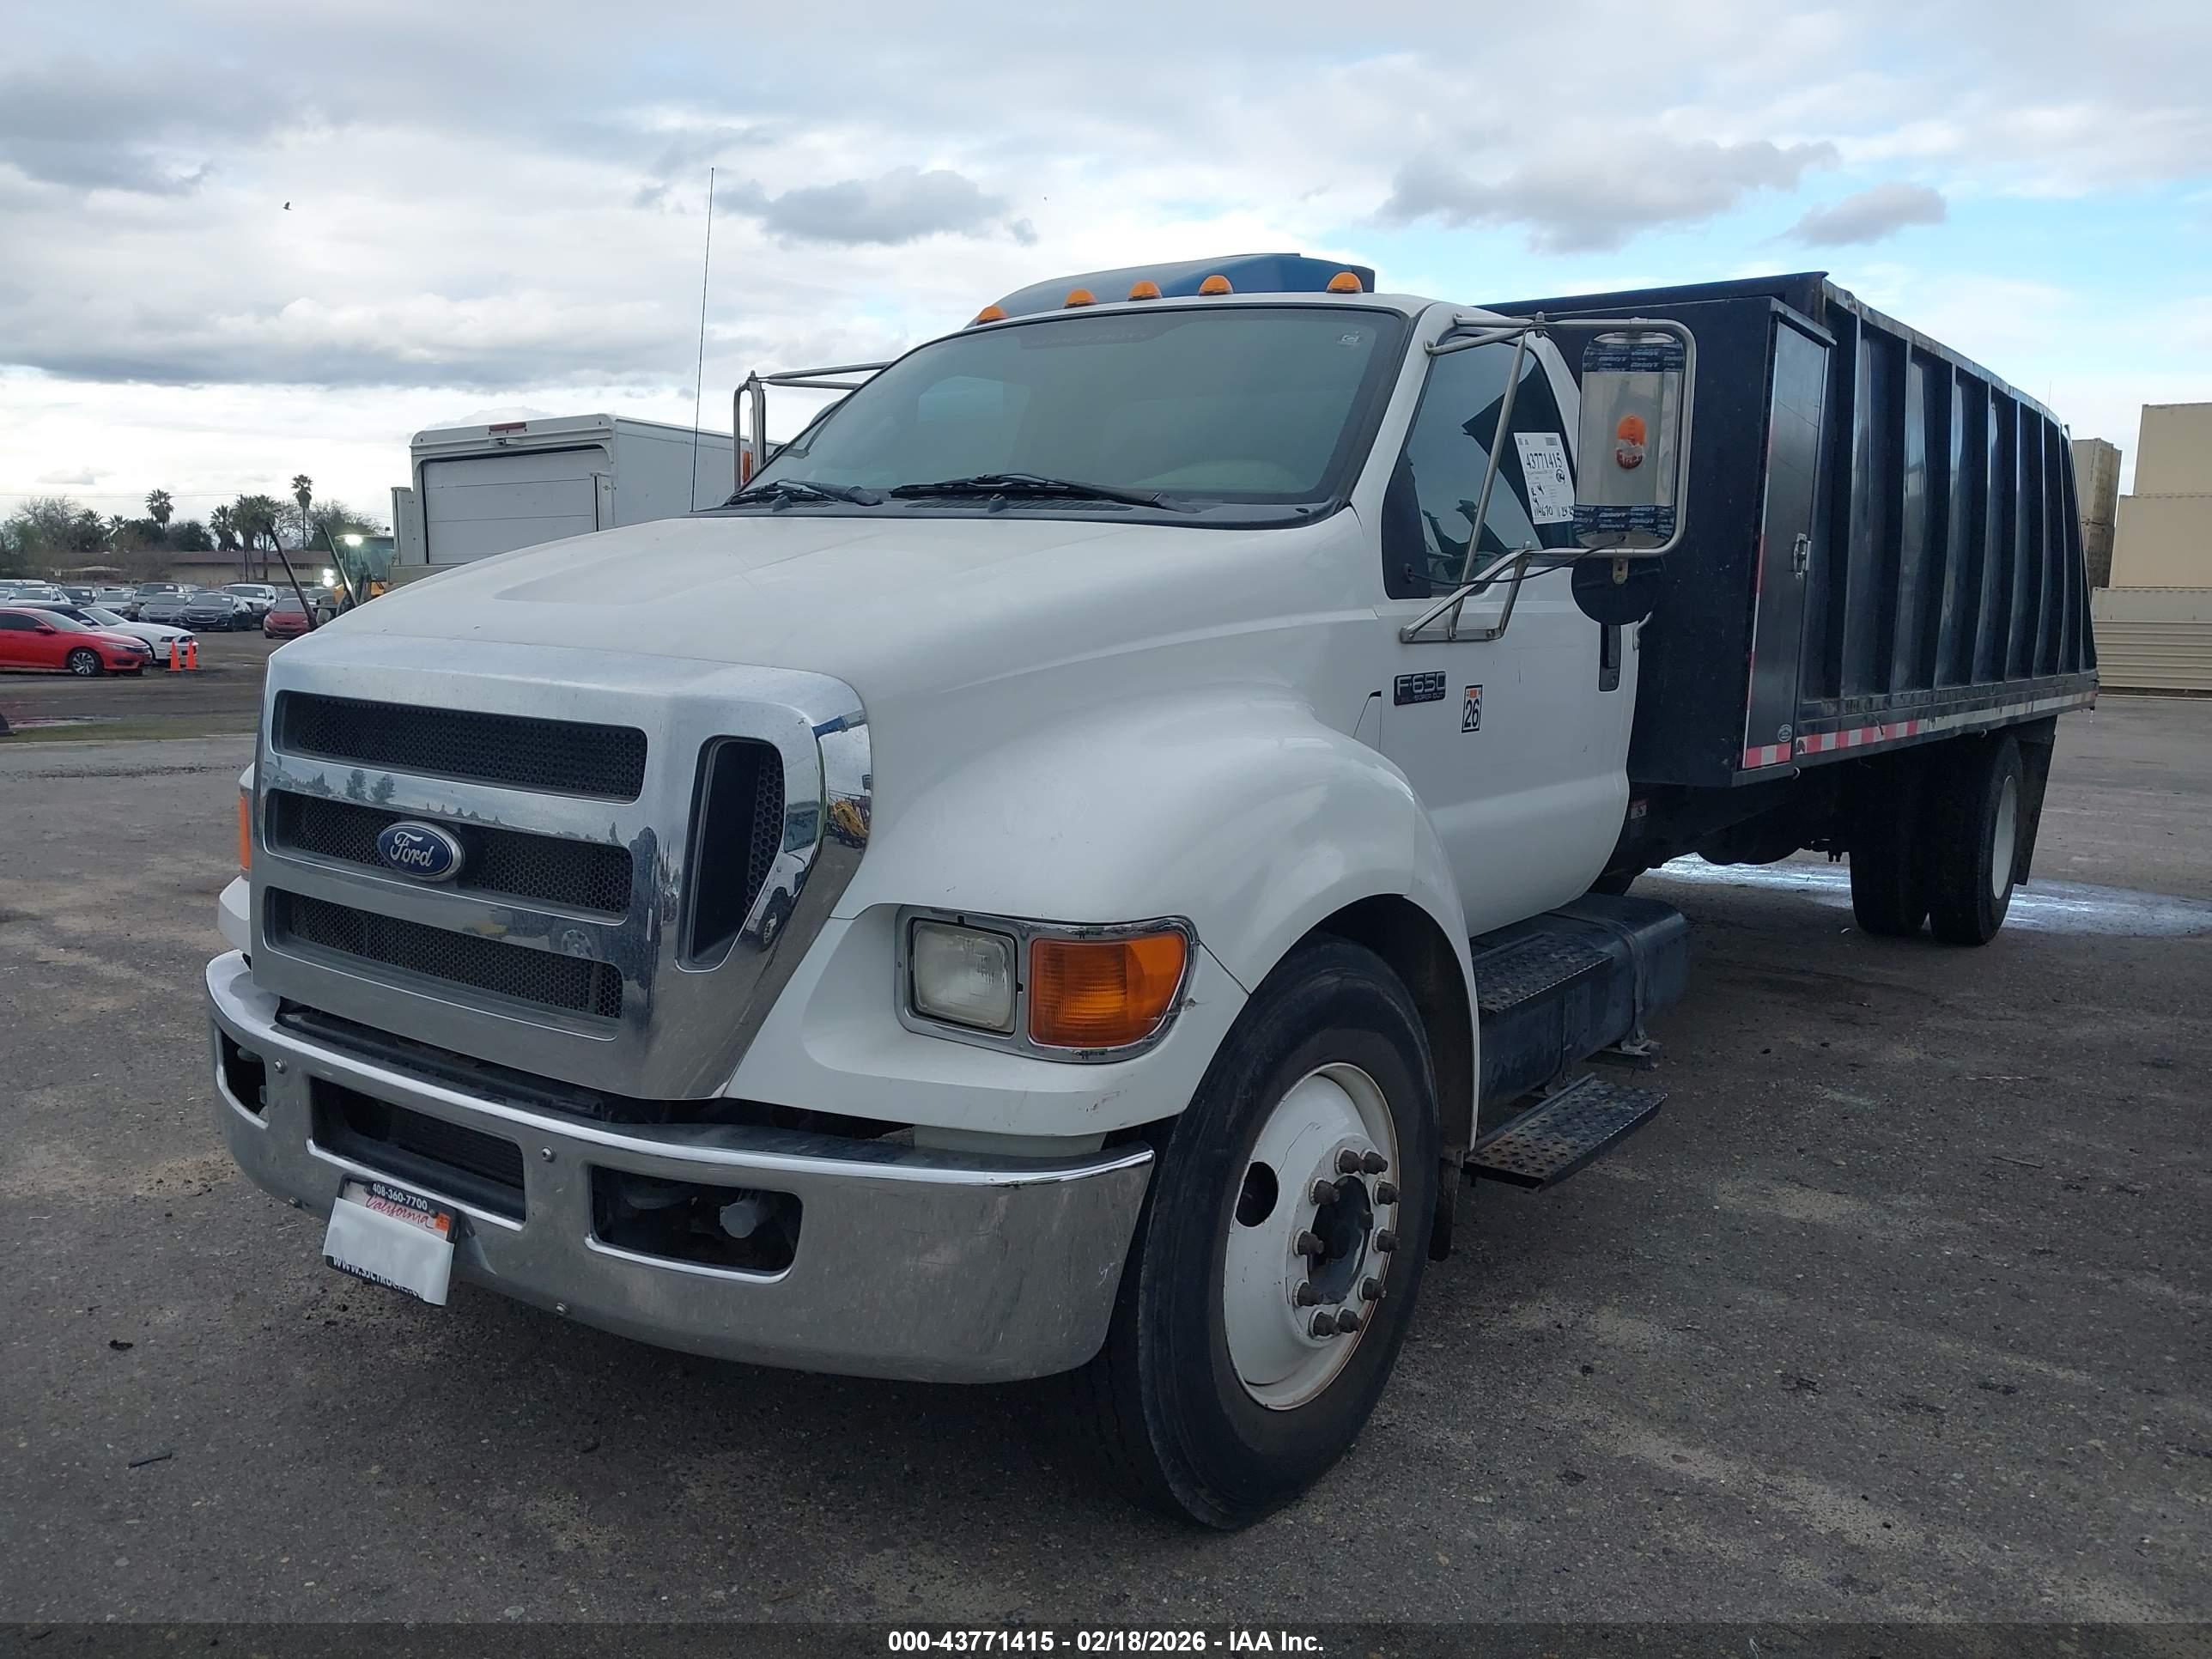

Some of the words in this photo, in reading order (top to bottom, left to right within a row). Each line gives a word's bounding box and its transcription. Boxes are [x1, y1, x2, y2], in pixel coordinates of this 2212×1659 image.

[1526, 453, 1563, 469] 43771415
[1463, 698, 1480, 728] 26
[390, 831, 434, 867] Ford
[372, 1182, 428, 1211] 408-360-7700
